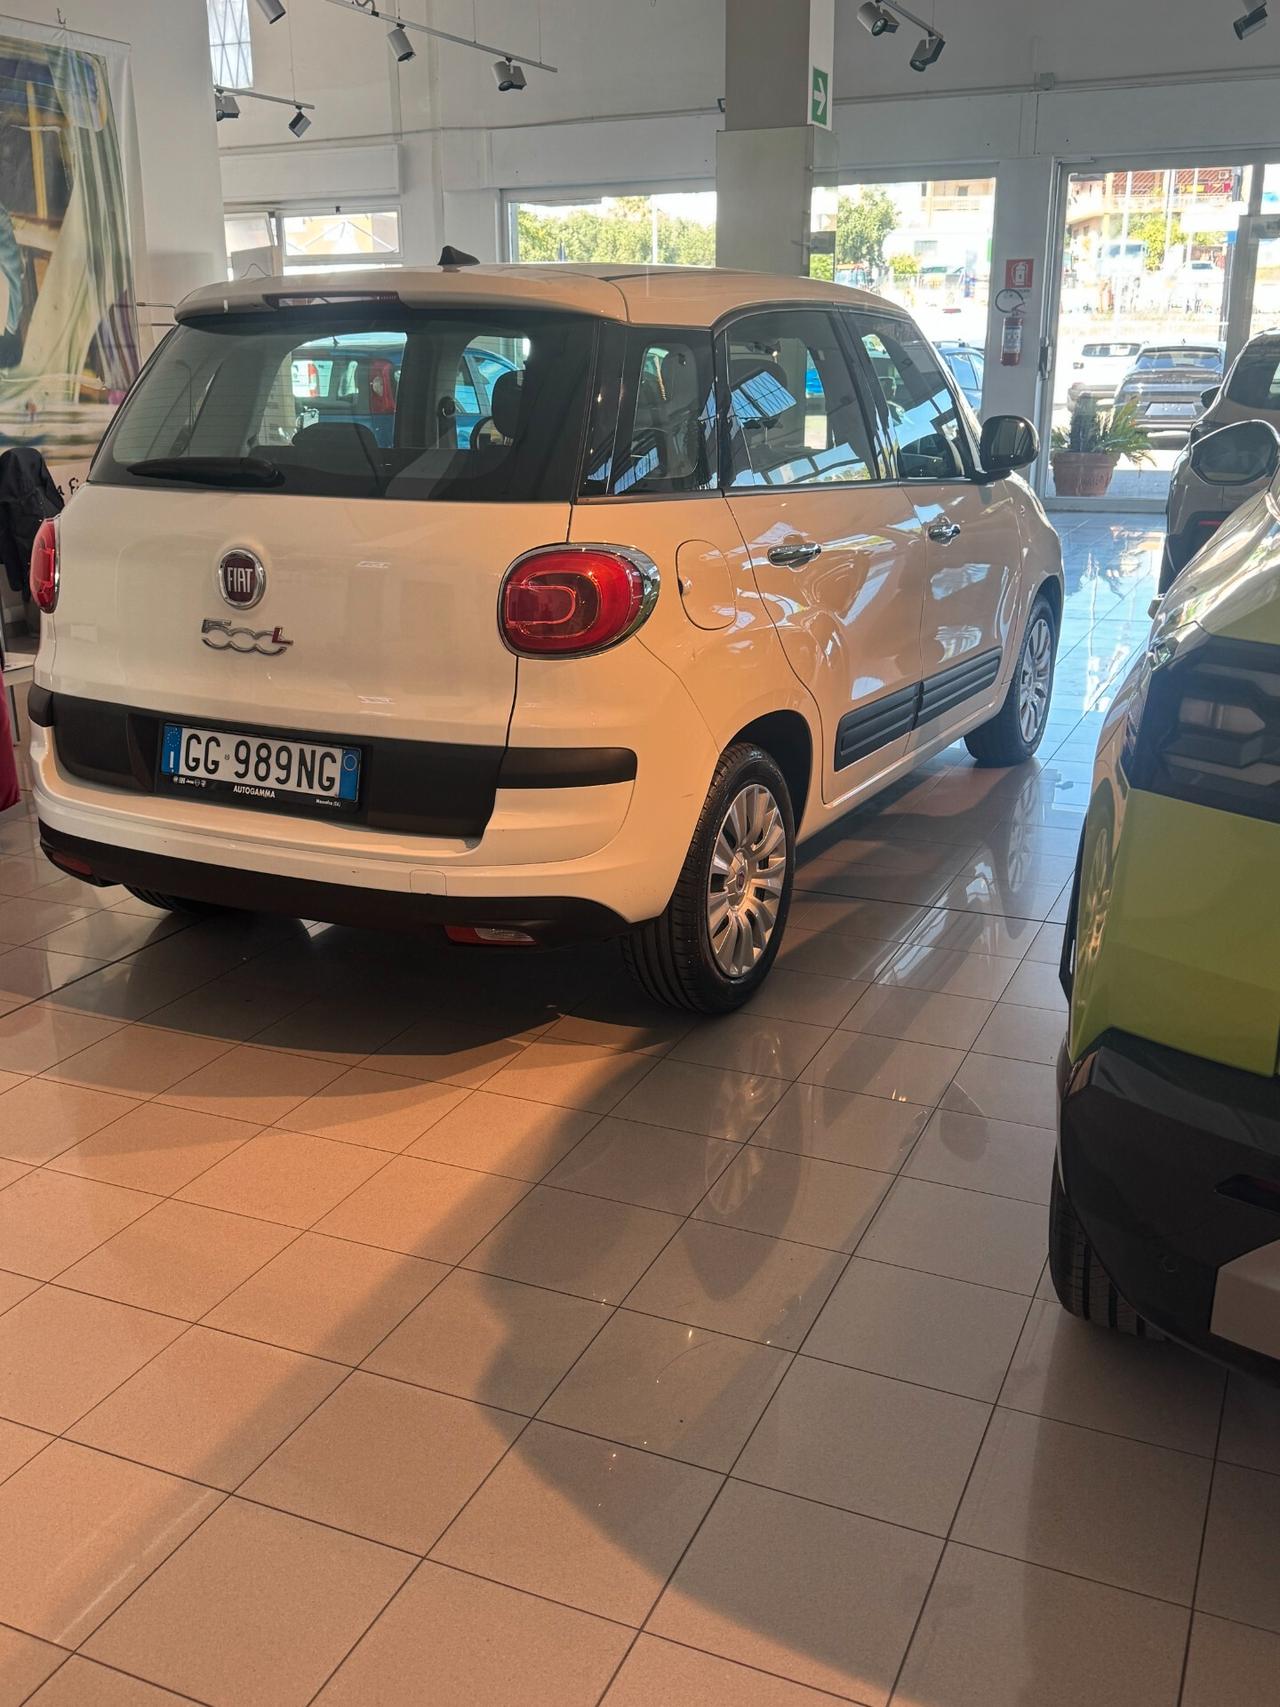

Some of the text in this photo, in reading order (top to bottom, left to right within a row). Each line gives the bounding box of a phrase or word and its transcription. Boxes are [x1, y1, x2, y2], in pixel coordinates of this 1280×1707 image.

[227, 566, 253, 593] FIAT
[201, 618, 294, 656] 500L
[184, 733, 337, 792] GG 989NG
[233, 785, 275, 799] AUTOGAMMA
